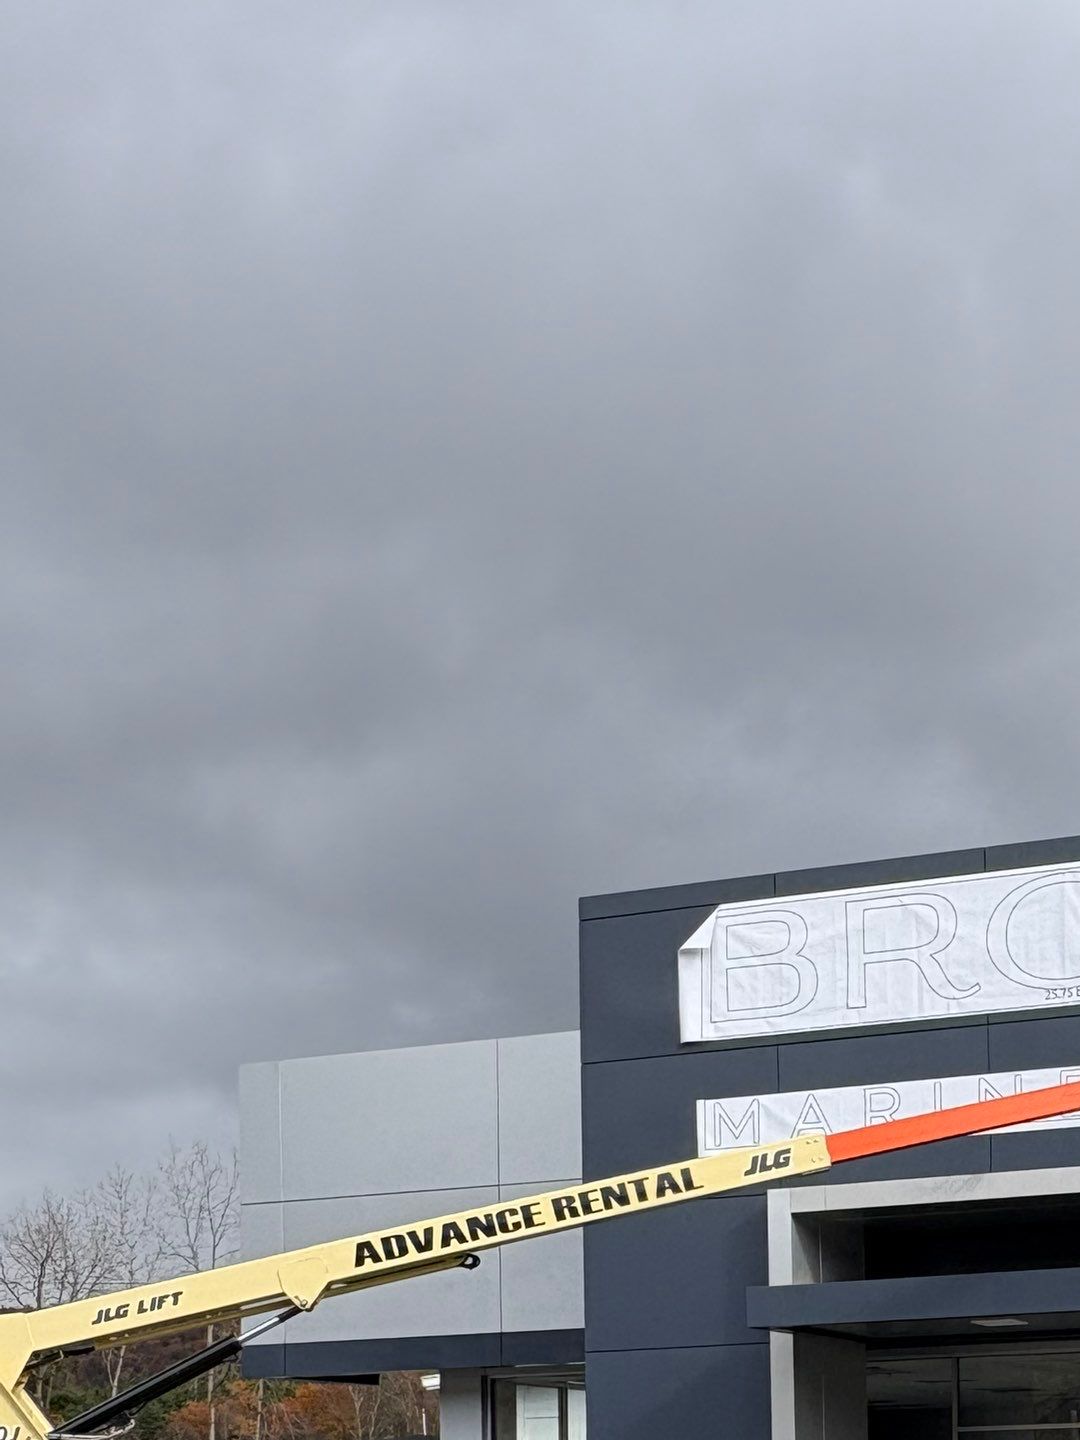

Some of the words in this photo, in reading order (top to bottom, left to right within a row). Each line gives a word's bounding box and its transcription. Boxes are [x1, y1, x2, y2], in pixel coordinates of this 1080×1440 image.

[744, 1147, 792, 1177] JLG
[354, 1203, 546, 1268] ADVANCE
[550, 1167, 704, 1222] RENTAL
[91, 1303, 130, 1326] JLG
[136, 1291, 184, 1314] LIFT
